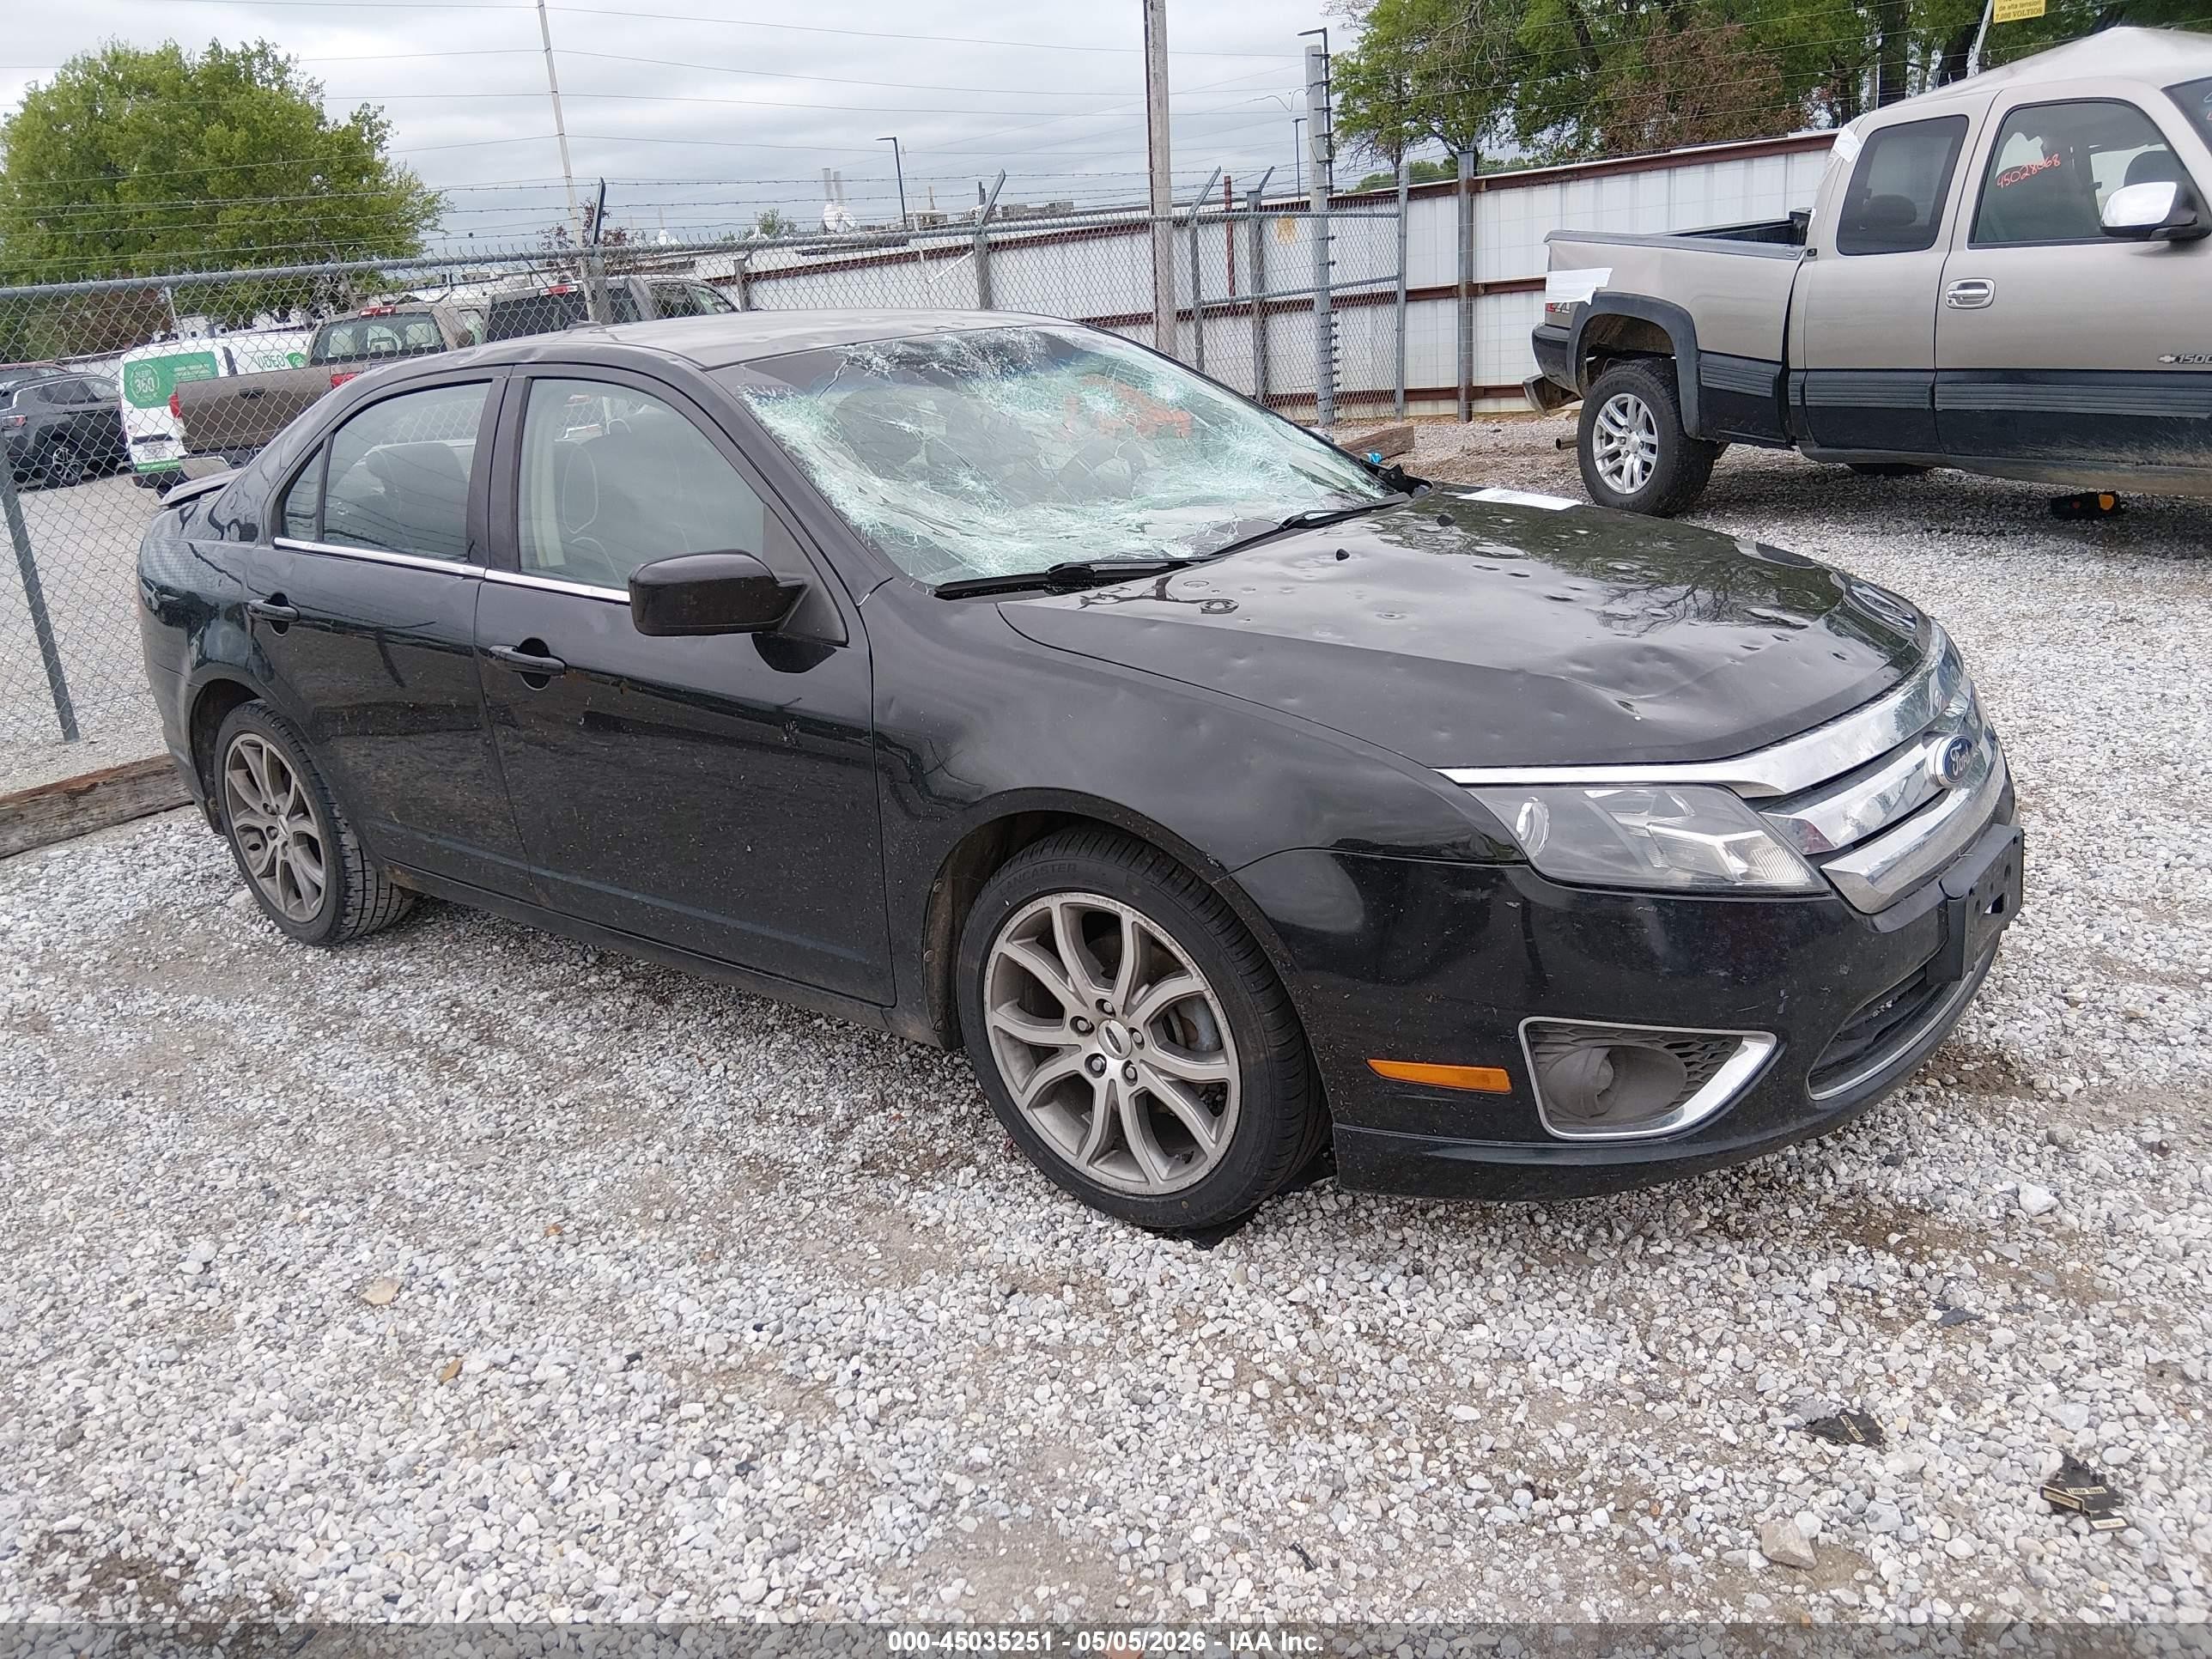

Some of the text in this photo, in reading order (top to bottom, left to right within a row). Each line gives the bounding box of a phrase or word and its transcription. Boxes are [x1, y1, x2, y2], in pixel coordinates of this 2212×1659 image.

[2013, 7, 2043, 17] VOLTIOS
[1997, 154, 2061, 188] 45028068
[254, 355, 286, 368] VIDEO
[135, 378, 155, 393] 360
[1950, 742, 1971, 776] Ford
